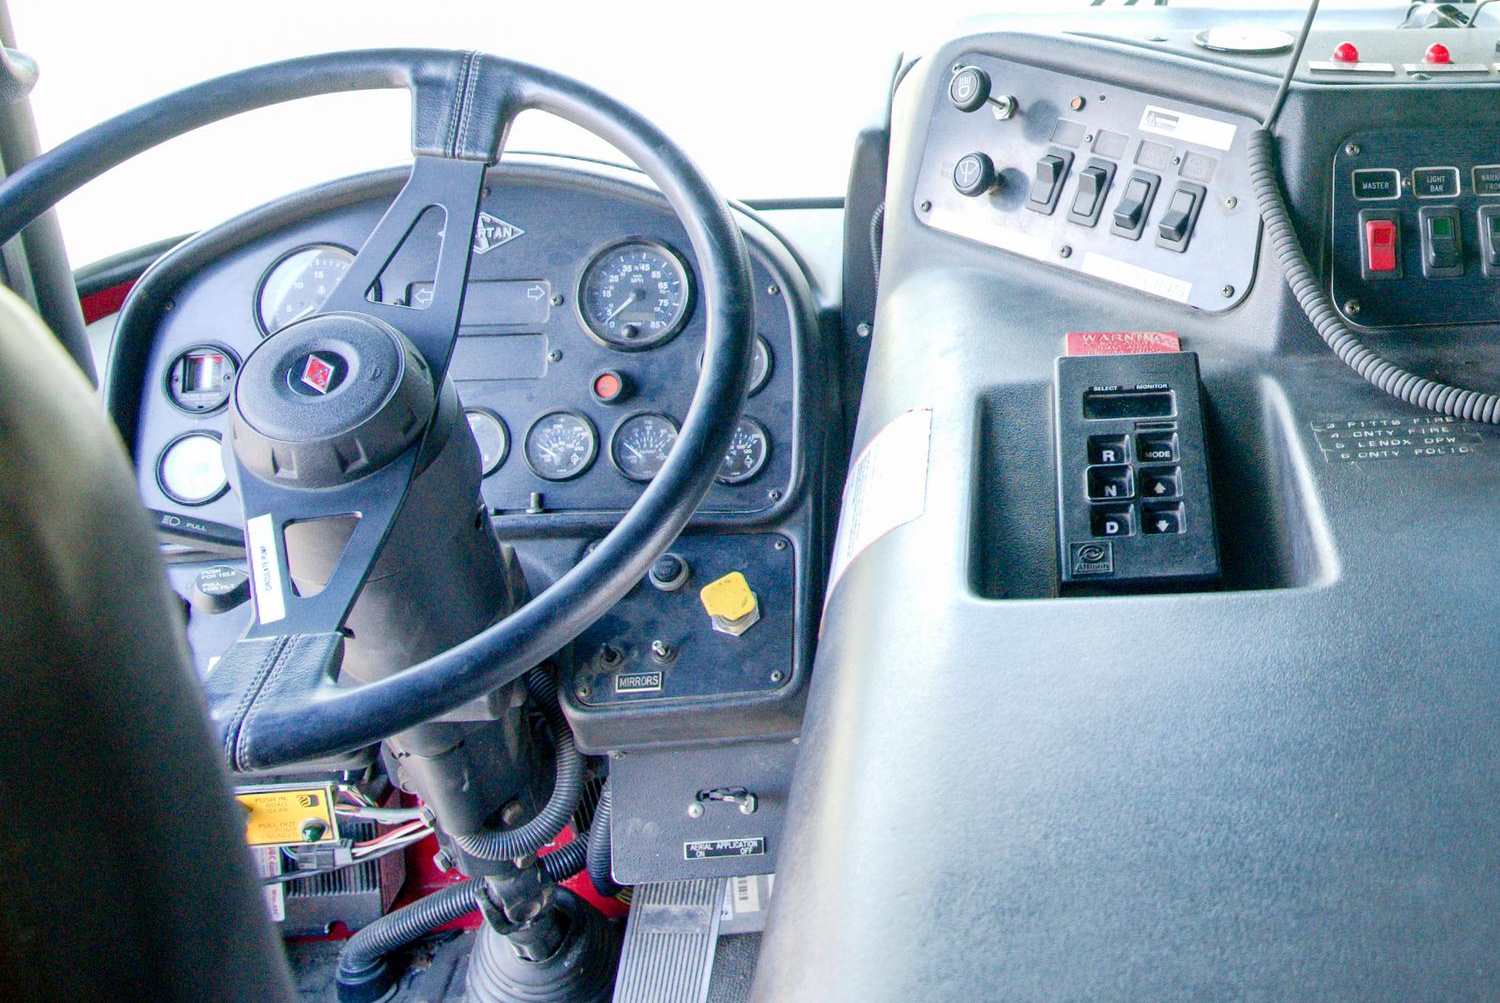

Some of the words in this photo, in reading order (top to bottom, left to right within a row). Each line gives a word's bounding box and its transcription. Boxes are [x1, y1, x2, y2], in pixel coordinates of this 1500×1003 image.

[1362, 181, 1389, 190] MASTER
[1430, 184, 1444, 192] BAR
[640, 263, 650, 271] 45
[314, 271, 324, 279] 15
[1082, 334, 1160, 342] WARNING
[1413, 416, 1454, 424] FIRE
[1408, 427, 1450, 435] FIRE
[1358, 439, 1412, 448] LENOX
[1102, 450, 1115, 462] R
[1145, 450, 1170, 458] MODE
[1104, 485, 1117, 496] N
[186, 522, 207, 531] PULL
[1106, 521, 1119, 534] D
[619, 675, 659, 687] MIRRORS
[690, 843, 714, 851] AERIAL
[716, 840, 758, 850] APPLICATION
